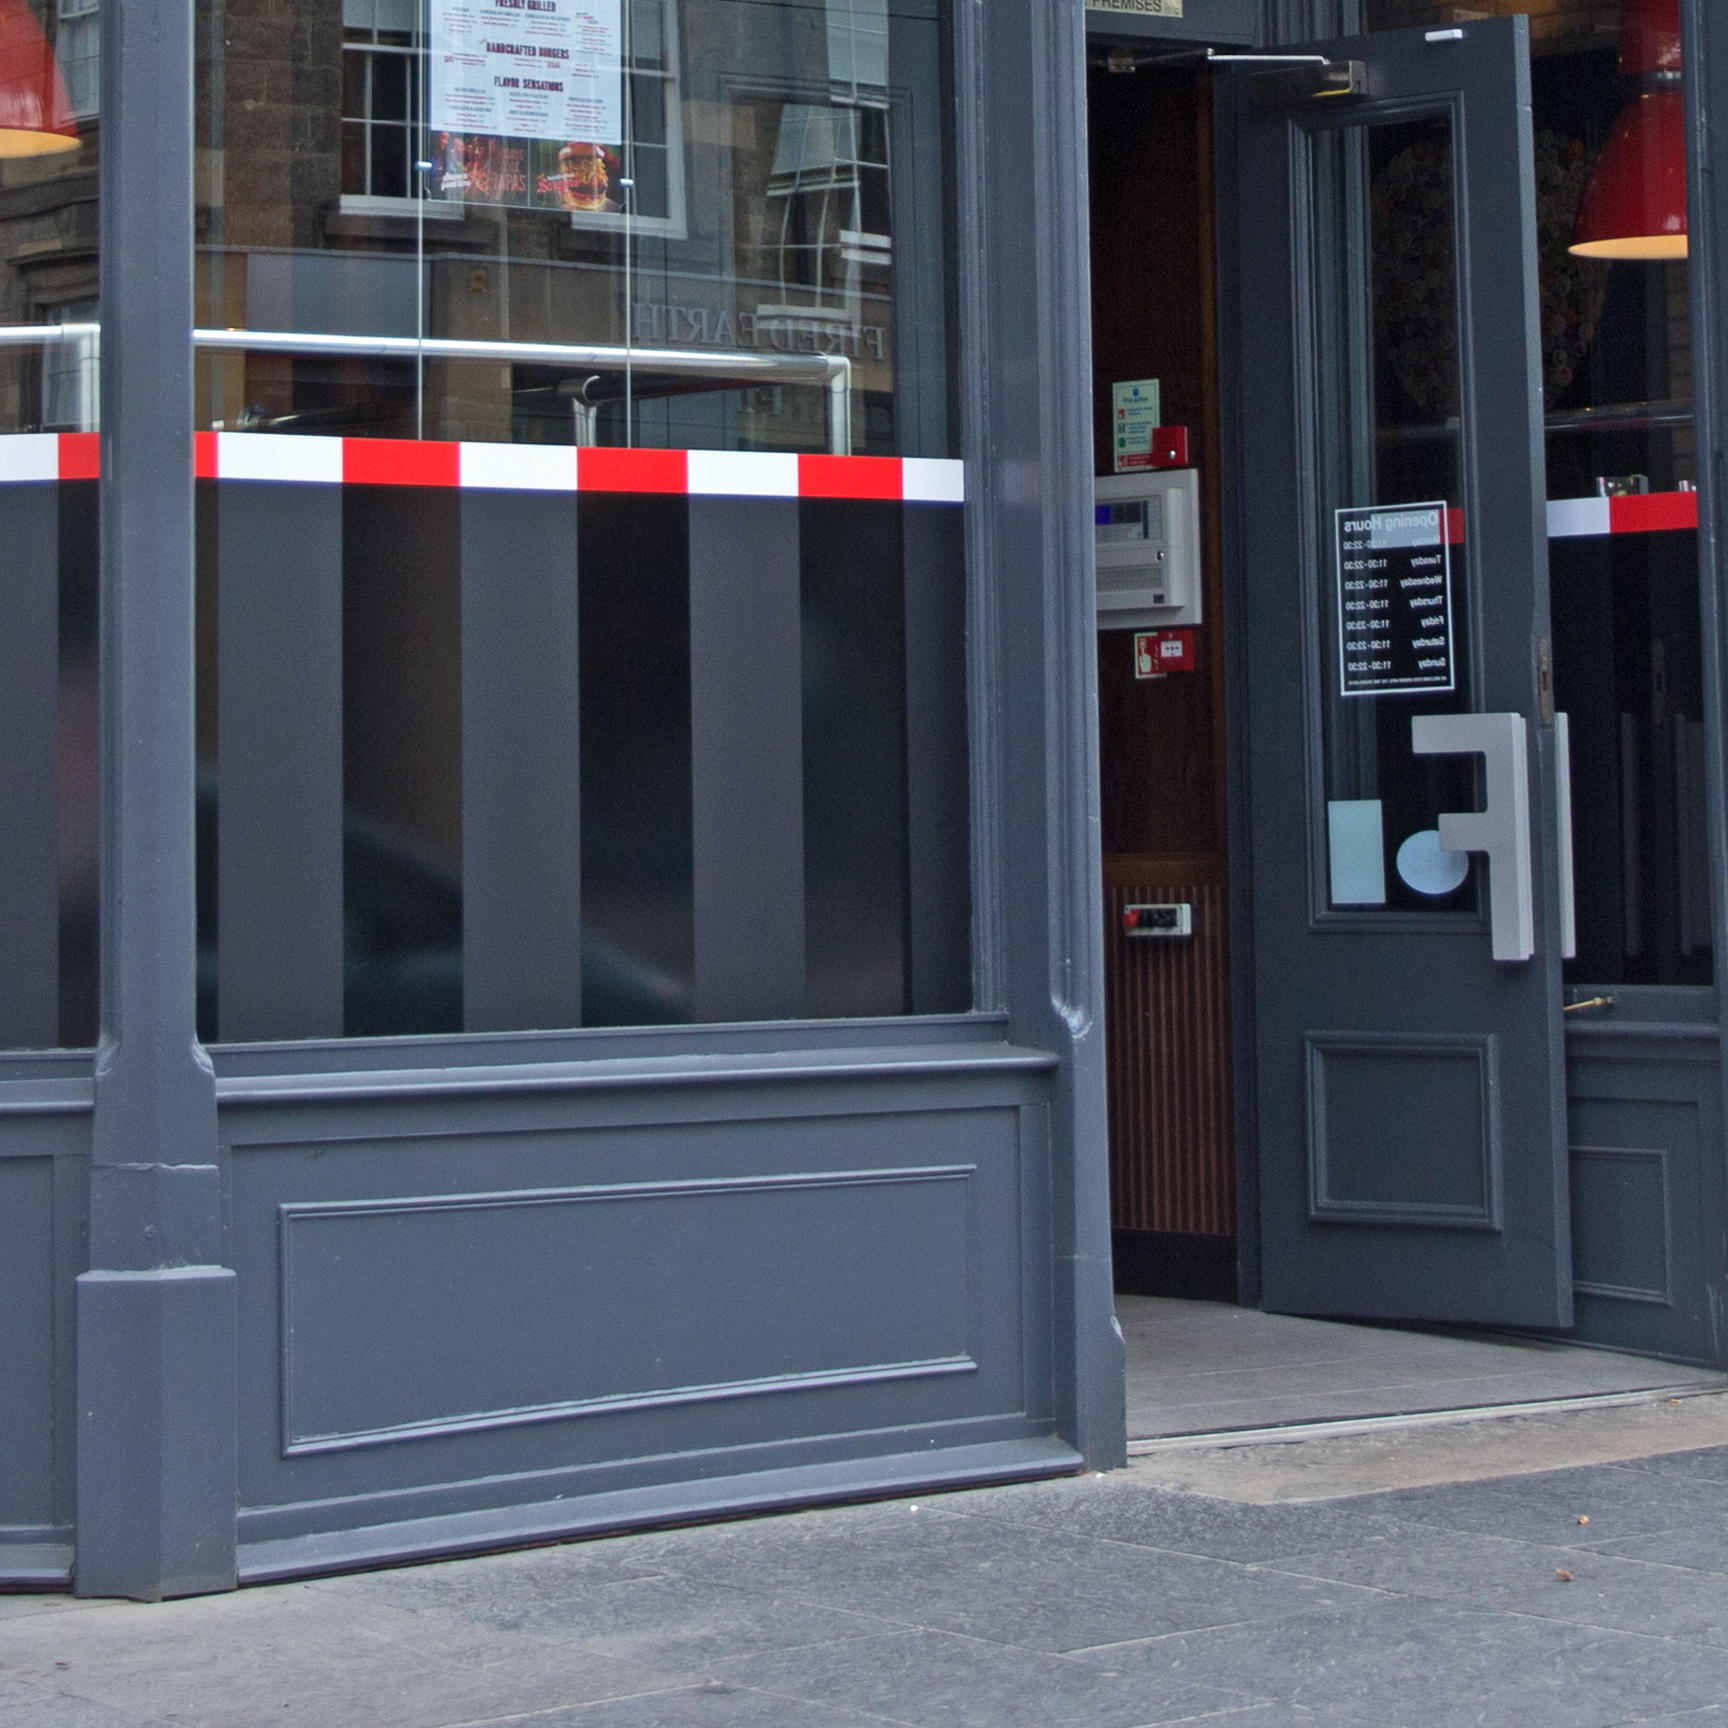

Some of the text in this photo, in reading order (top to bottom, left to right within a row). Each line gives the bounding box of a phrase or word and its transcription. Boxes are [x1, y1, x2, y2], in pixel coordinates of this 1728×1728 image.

[486, 42, 536, 56] HANDCRAFTED
[494, 76, 564, 92] FLAVOR SENSATIONS
